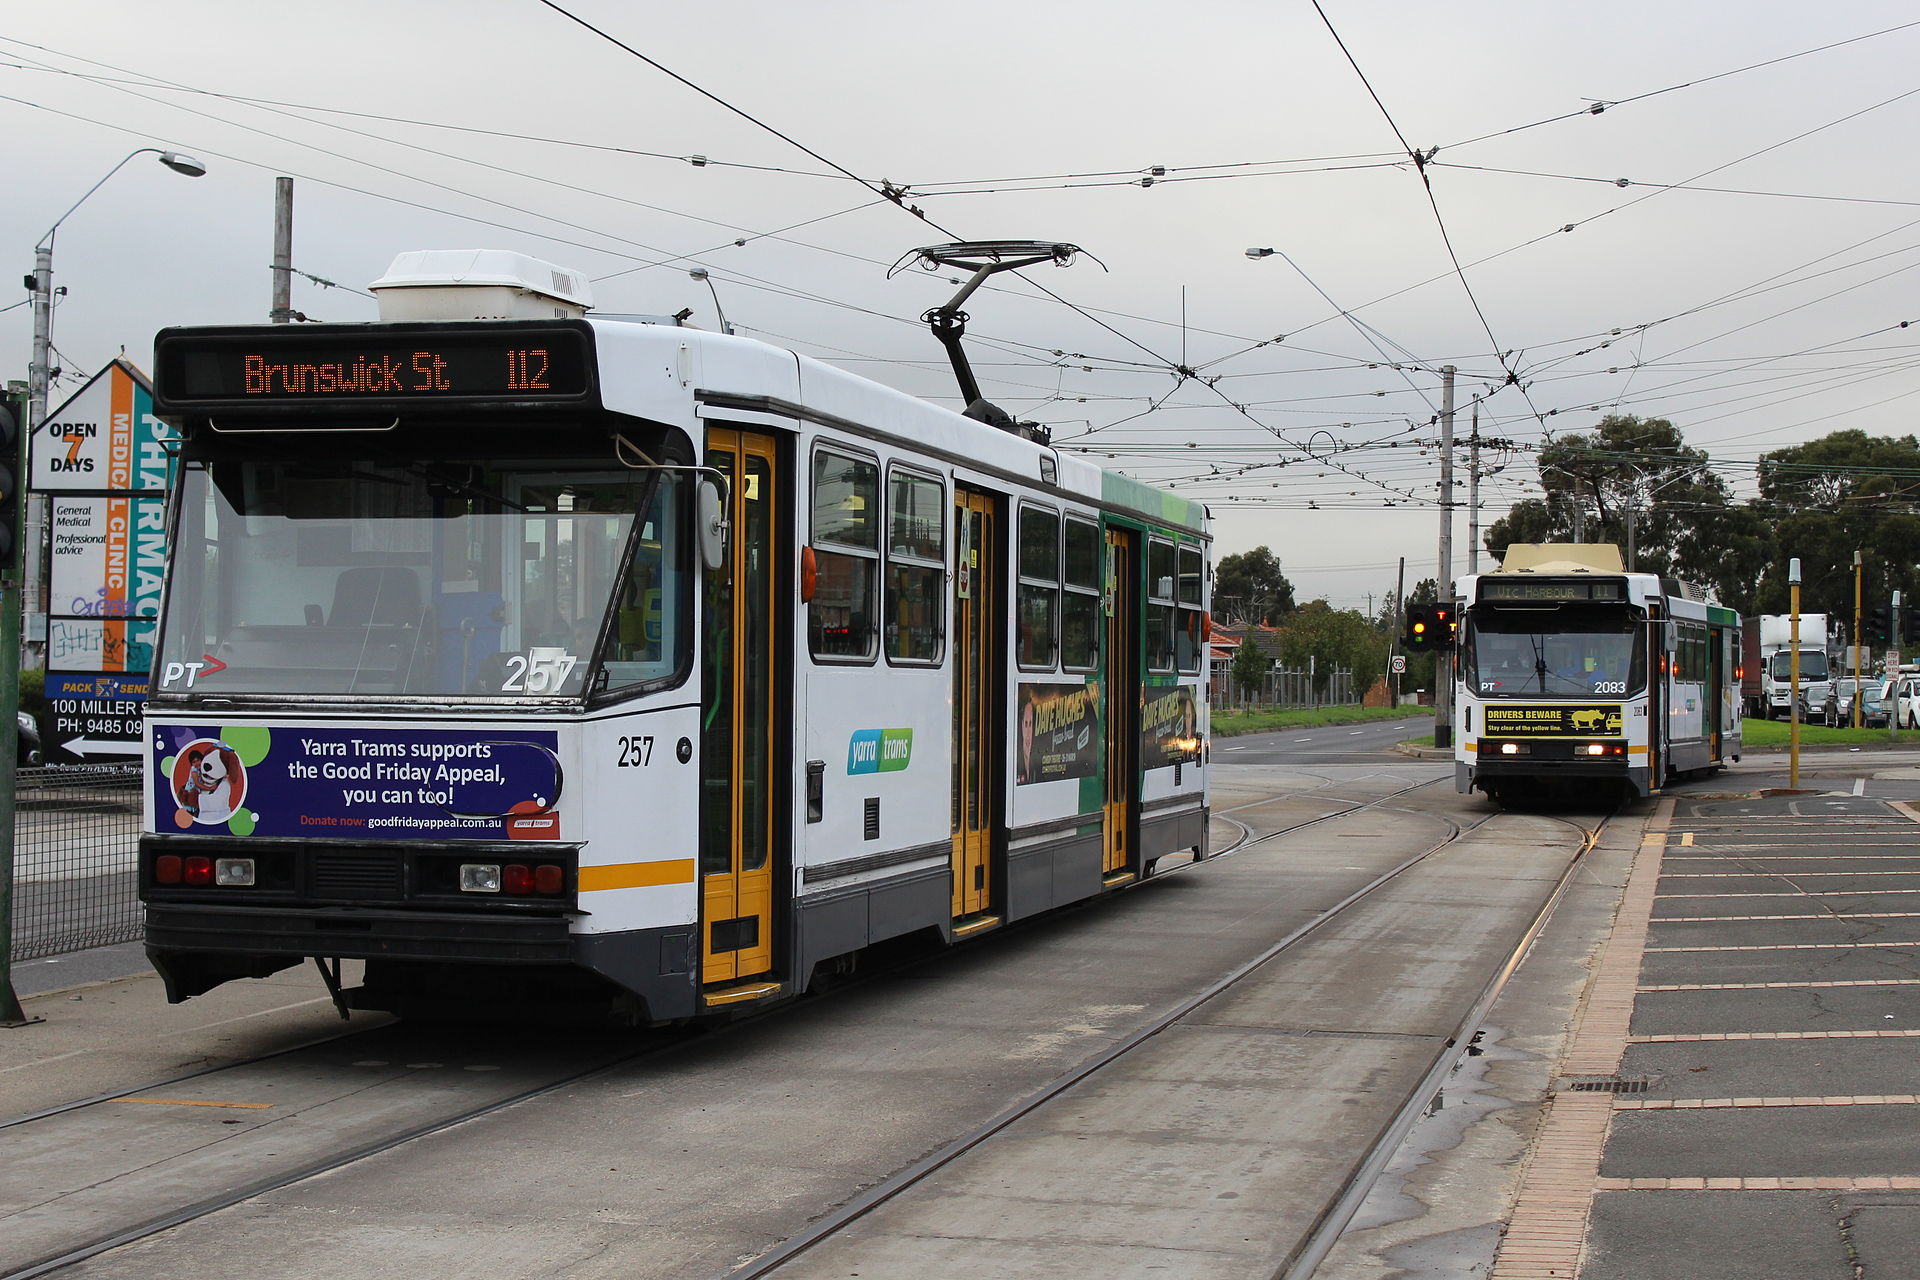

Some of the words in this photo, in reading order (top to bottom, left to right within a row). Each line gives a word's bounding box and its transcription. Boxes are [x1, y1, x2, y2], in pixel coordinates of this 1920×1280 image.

[244, 354, 403, 394] Brunswick
[412, 351, 450, 391] St
[506, 349, 549, 389] 112
[50, 423, 96, 438] OPEN
[62, 433, 85, 464] 7
[51, 458, 94, 472] DAYS
[56, 505, 91, 515] General
[56, 517, 91, 527] Medical
[55, 534, 107, 546] Professional
[55, 545, 83, 555] advice
[108, 517, 126, 590] CLINIC
[502, 655, 577, 692] 257
[62, 683, 93, 693] PACK
[1594, 681, 1627, 694] 2083
[52, 700, 76, 714] 100
[81, 700, 136, 715] MILLER
[1035, 700, 1056, 737] DAVE
[1055, 688, 1086, 729] HUGHES
[1487, 710, 1524, 720] DRIVERS
[1525, 710, 1562, 719] BEWARE
[57, 718, 82, 733] PH:
[87, 719, 122, 734] 9485
[1487, 724, 1500, 732] Stay
[1531, 724, 1549, 732] yellow
[301, 738, 347, 756] Yarra
[351, 739, 406, 757] Trams
[410, 742, 492, 762] supports
[617, 736, 655, 768] 257
[852, 740, 877, 769] yarra
[884, 735, 908, 760] trams
[287, 761, 318, 779] the
[322, 762, 371, 780] Good
[376, 762, 432, 785] Friday
[434, 764, 505, 786] Appeal,
[342, 789, 376, 807] you
[381, 790, 413, 804] can
[417, 786, 453, 805] too!
[300, 815, 337, 826] Donate
[340, 817, 366, 827] now:
[367, 816, 502, 830] goodfridayappeal.com.au
